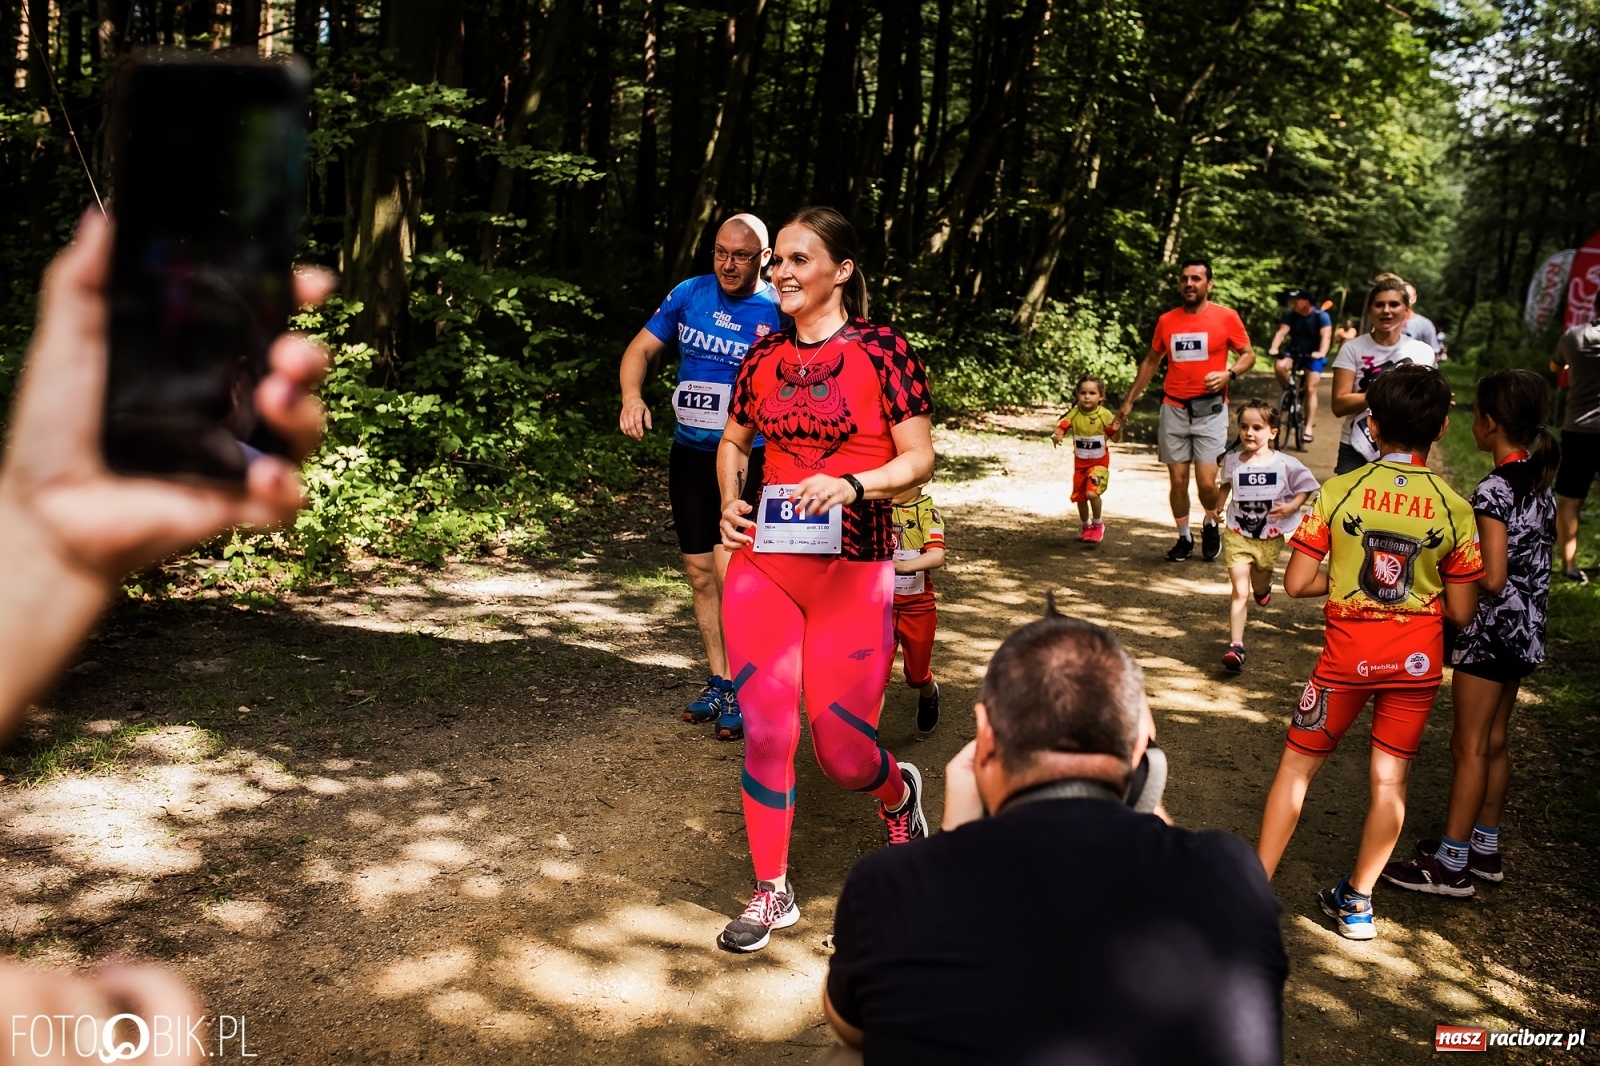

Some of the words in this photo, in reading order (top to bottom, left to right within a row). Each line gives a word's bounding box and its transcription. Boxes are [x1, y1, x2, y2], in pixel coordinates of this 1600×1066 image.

[1181, 341, 1195, 350] 76
[684, 393, 713, 409] 112
[1082, 441, 1094, 449] 77
[1248, 473, 1267, 485] 66
[1361, 488, 1436, 520] RAFAŁ
[1378, 588, 1397, 599] OCR
[847, 649, 875, 661] 4F
[1370, 662, 1399, 671] MebRaj
